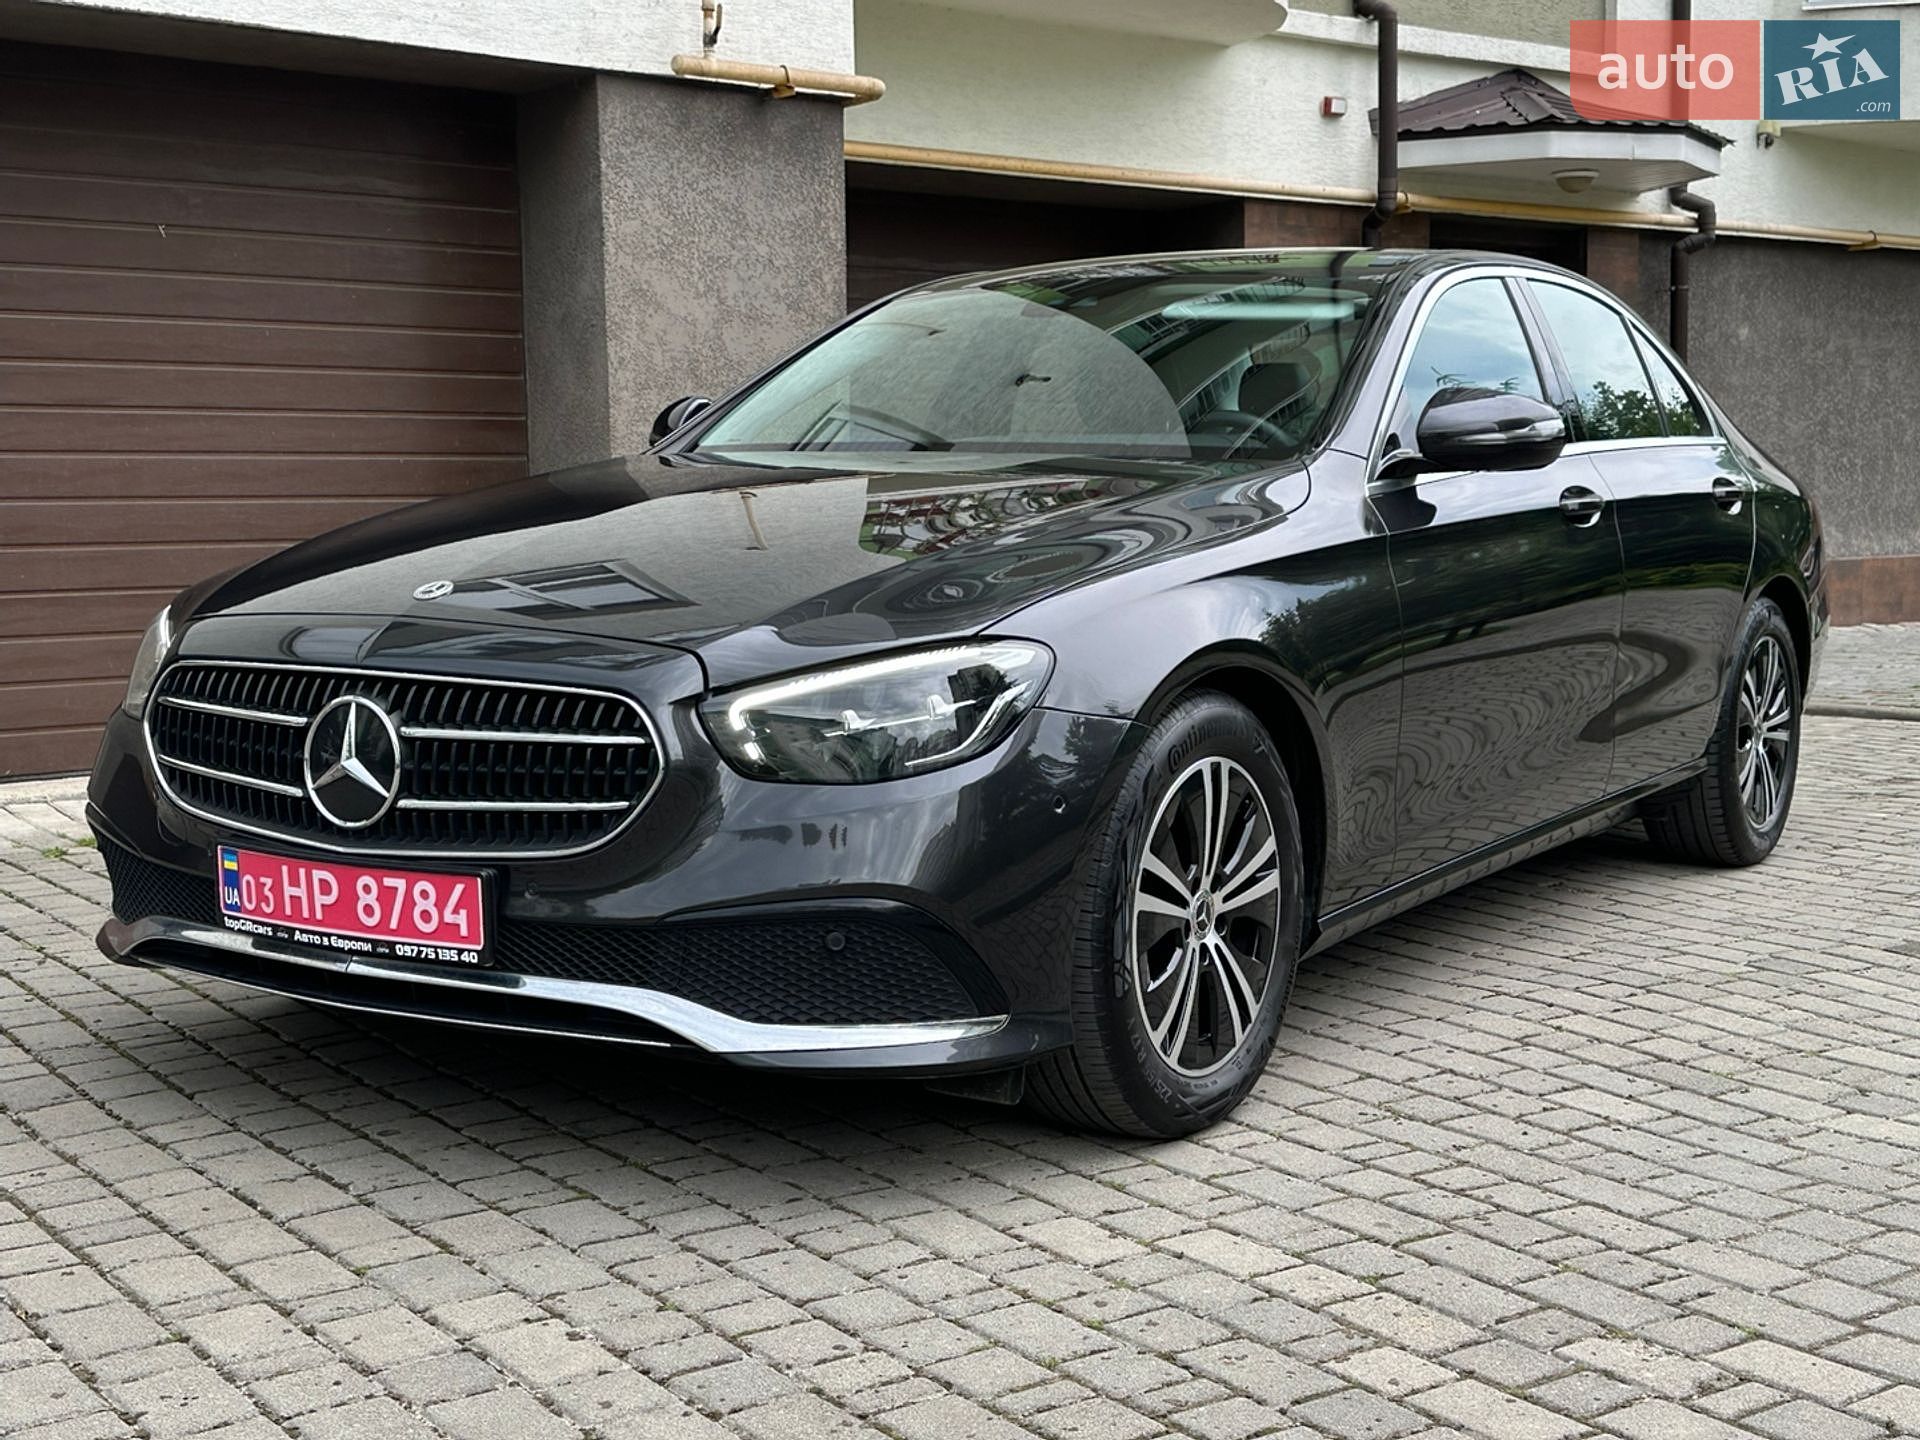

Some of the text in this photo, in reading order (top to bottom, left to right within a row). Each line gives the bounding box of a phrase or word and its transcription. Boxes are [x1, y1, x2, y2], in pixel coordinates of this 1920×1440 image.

[224, 886, 241, 907] UA
[241, 864, 469, 937] 03 HP 8784
[293, 929, 322, 946] Авто
